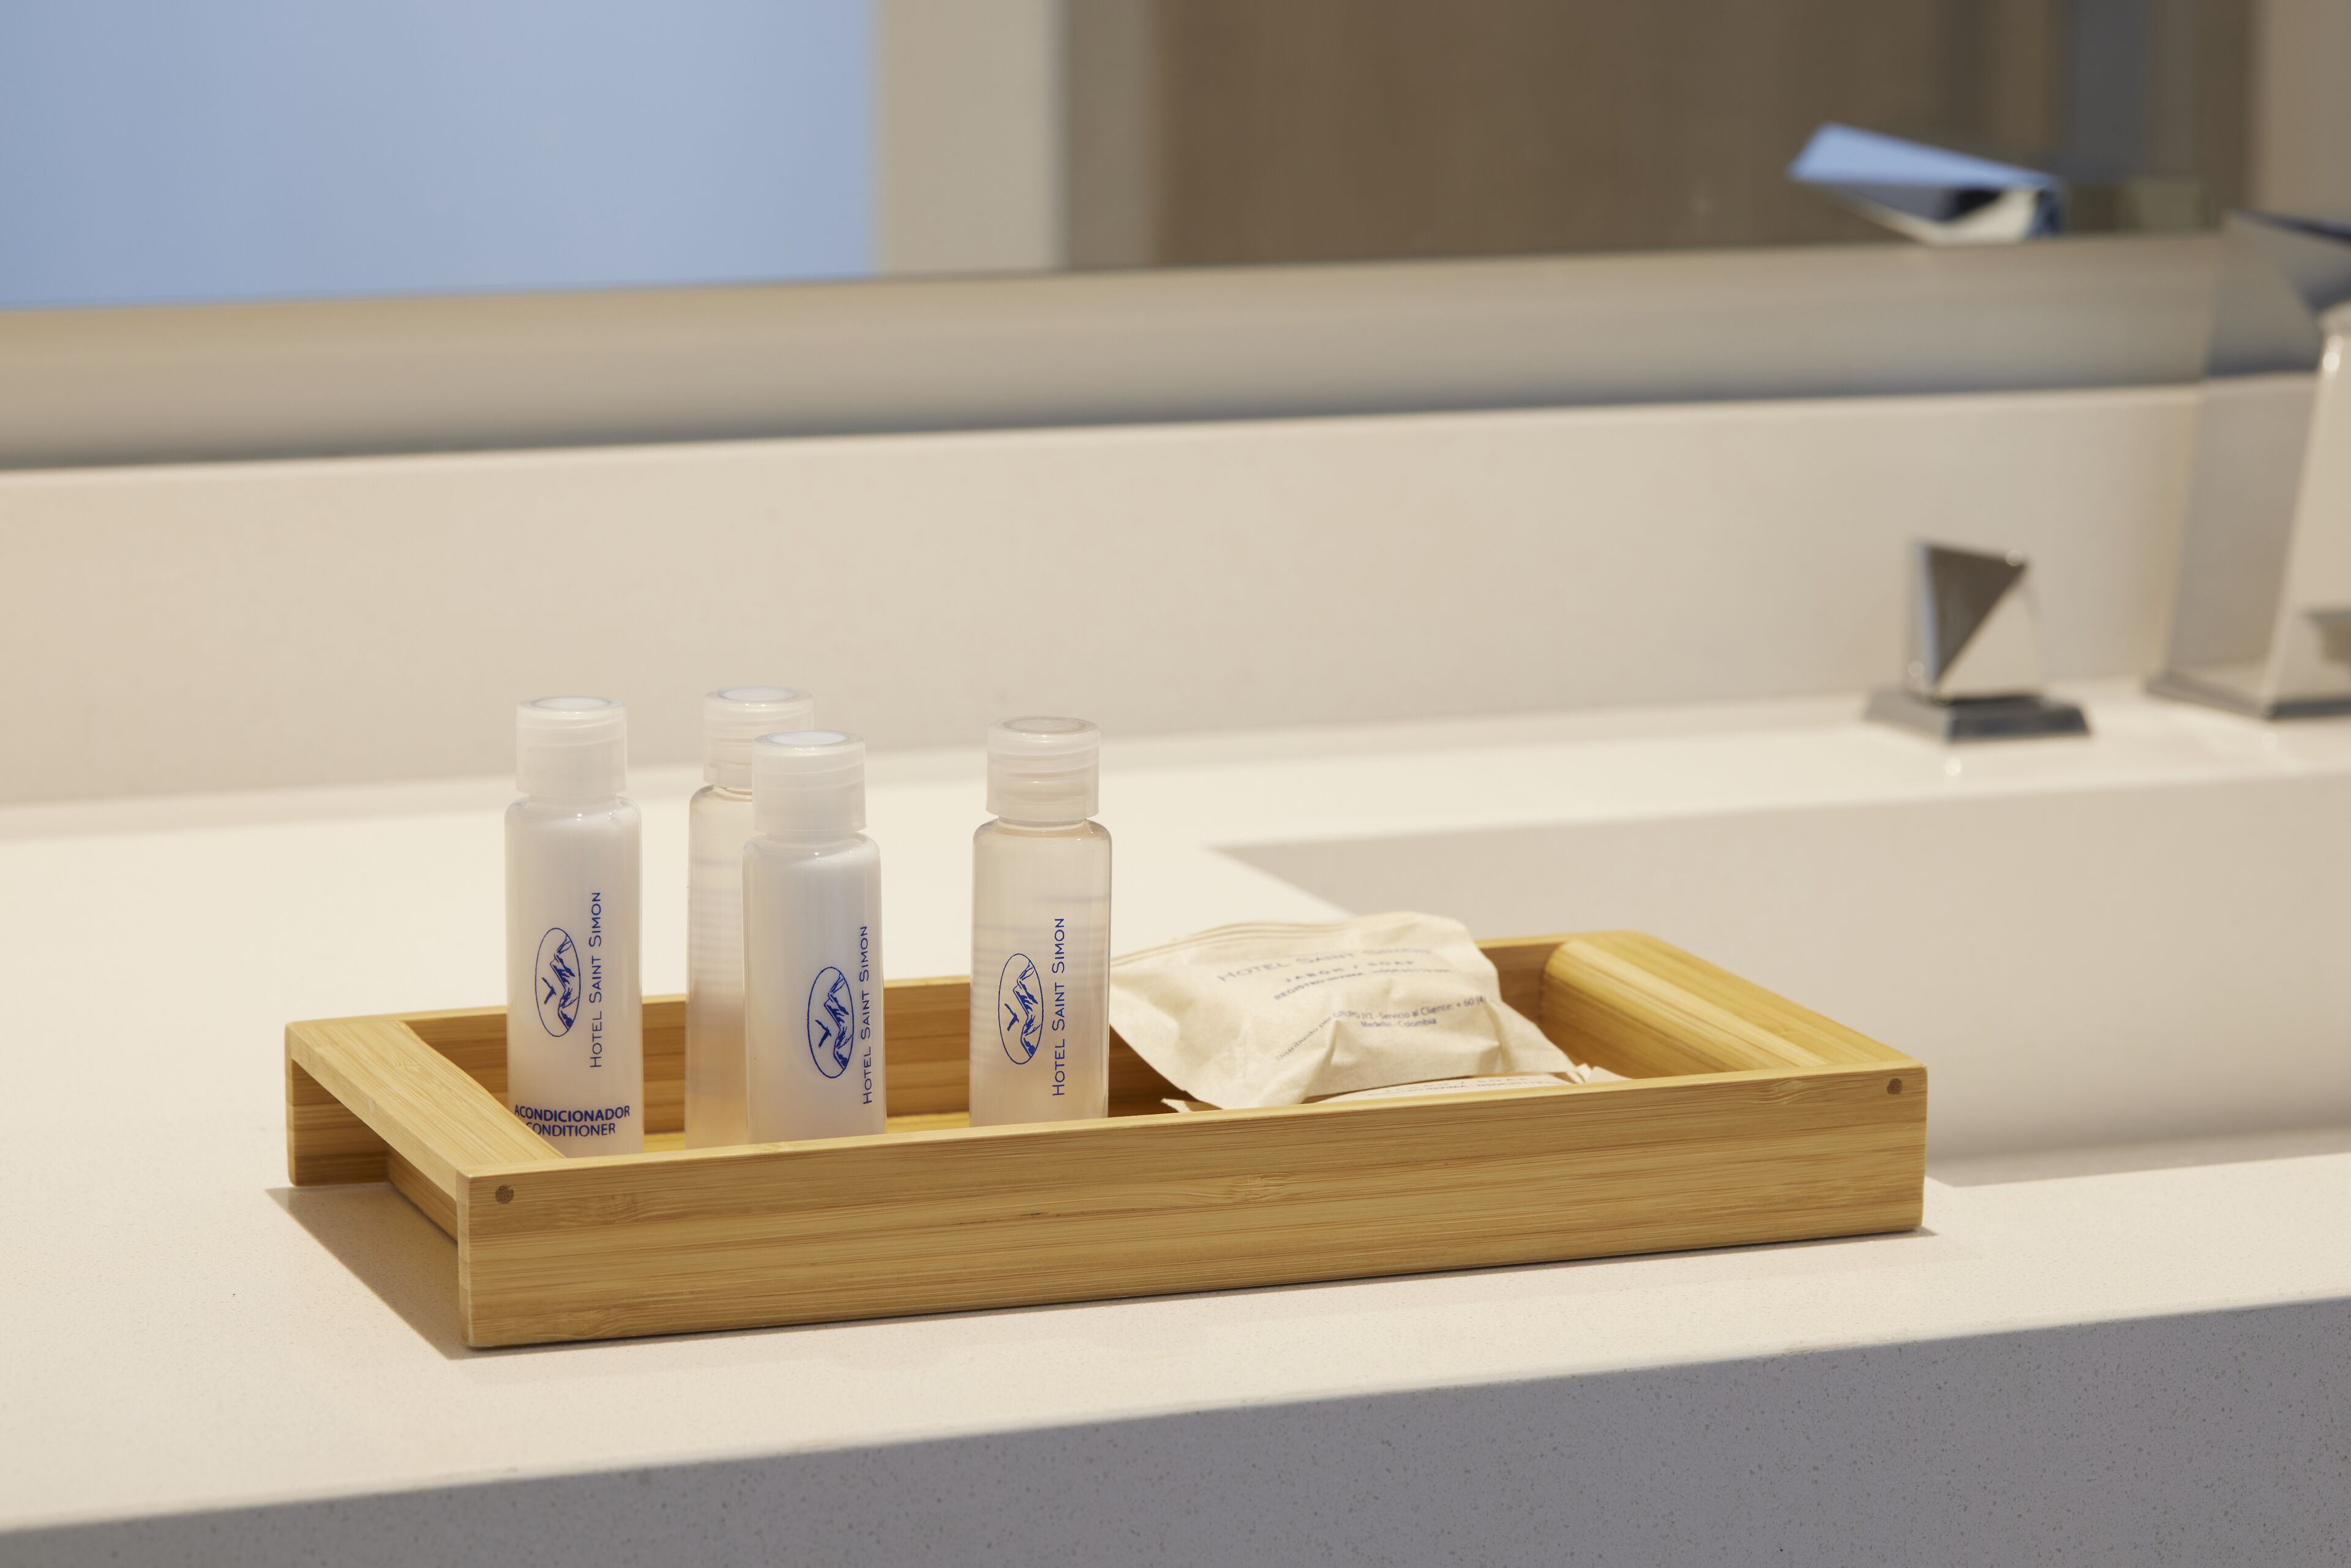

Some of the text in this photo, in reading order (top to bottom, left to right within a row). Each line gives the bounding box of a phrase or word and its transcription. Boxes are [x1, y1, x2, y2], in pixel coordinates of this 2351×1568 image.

[588, 892, 602, 1068] HOTEL SAINT SIMON
[859, 926, 872, 1105] HOTEL SAINT SIMON
[1051, 918, 1065, 1096] HOTEL SAINT SIMON
[514, 1105, 630, 1123] ACONDICIONADOR
